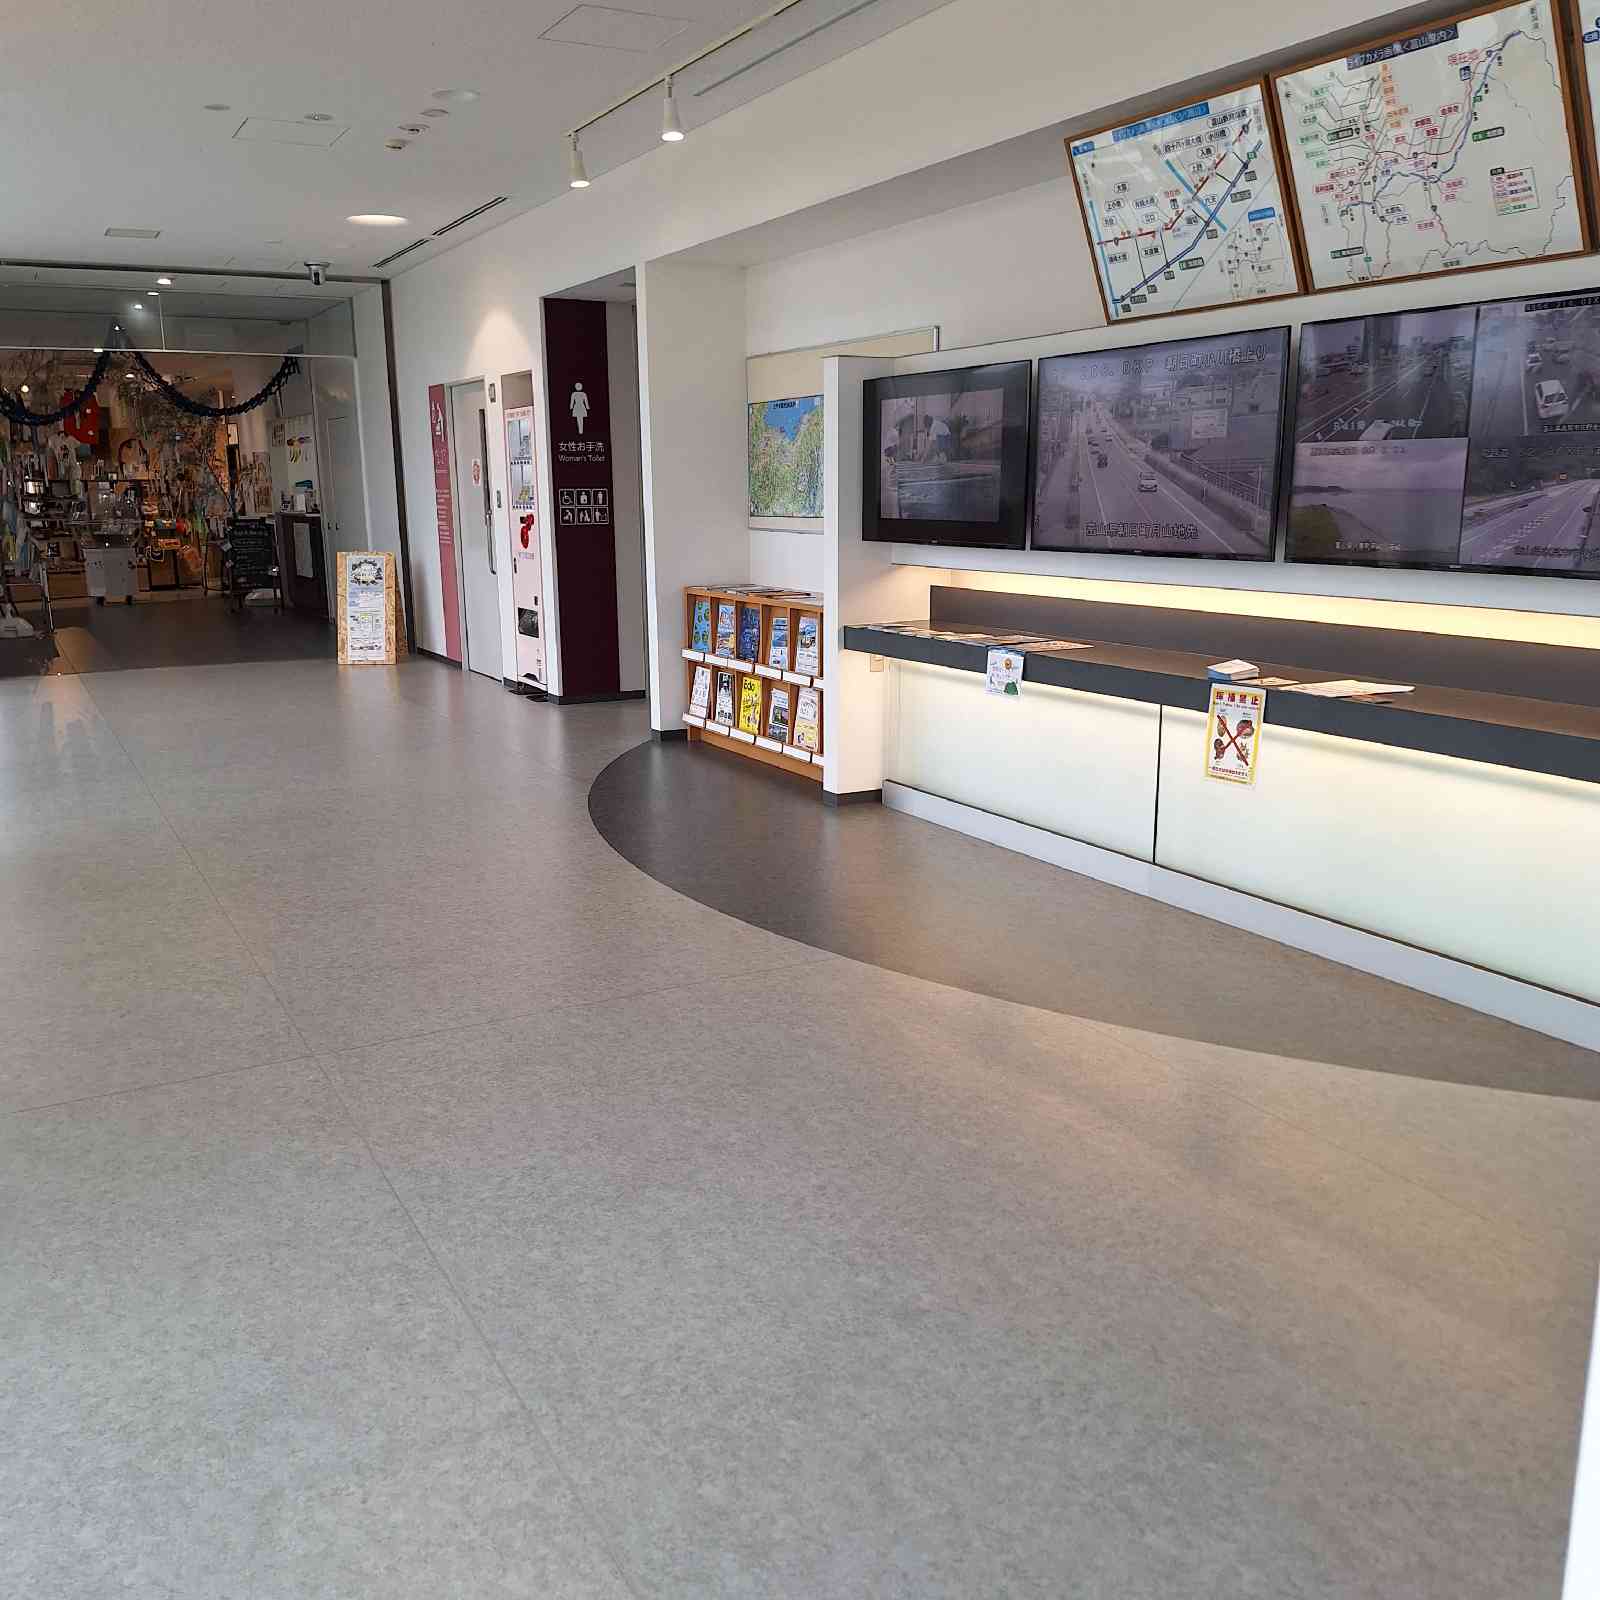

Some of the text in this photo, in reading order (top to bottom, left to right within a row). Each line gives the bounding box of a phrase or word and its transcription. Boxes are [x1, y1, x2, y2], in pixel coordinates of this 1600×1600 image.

[559, 441, 605, 453] 女性お手洗
